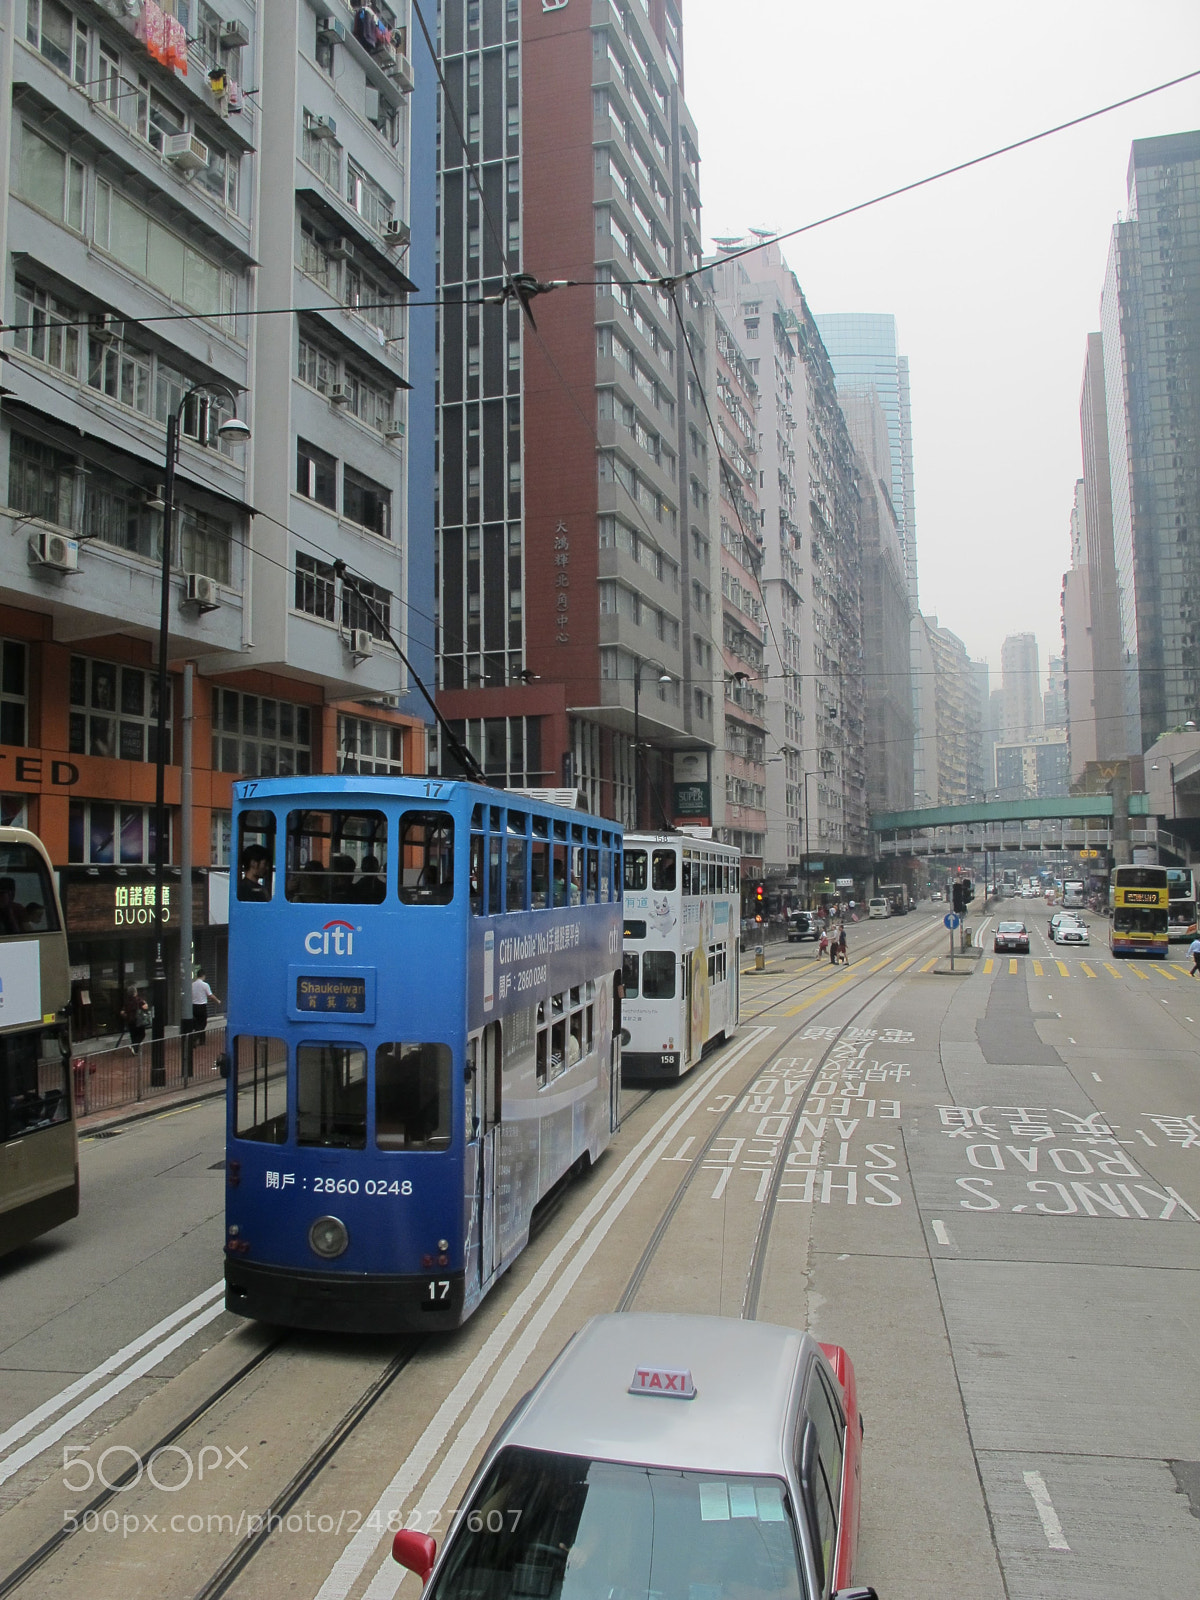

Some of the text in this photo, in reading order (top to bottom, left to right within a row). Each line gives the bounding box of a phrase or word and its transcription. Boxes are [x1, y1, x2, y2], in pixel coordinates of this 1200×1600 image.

[242, 783, 258, 798] 17
[423, 781, 443, 798] 17
[499, 938, 512, 965] Citi
[517, 969, 532, 992] 2860
[661, 1055, 675, 1064] 158
[747, 1078, 867, 1098] ROAD
[707, 1094, 901, 1119] ELECTRIC
[755, 1115, 860, 1141] AND
[934, 1104, 1134, 1146] 英皇道
[661, 1136, 897, 1170] STREET
[966, 1144, 1142, 1177] ROAD
[313, 1177, 360, 1195] 2860
[364, 1179, 413, 1196] 0248
[701, 1165, 902, 1207] SHELL
[959, 1177, 1200, 1222] KING'S
[428, 1281, 450, 1300] 17
[638, 1371, 686, 1391] TAXI
